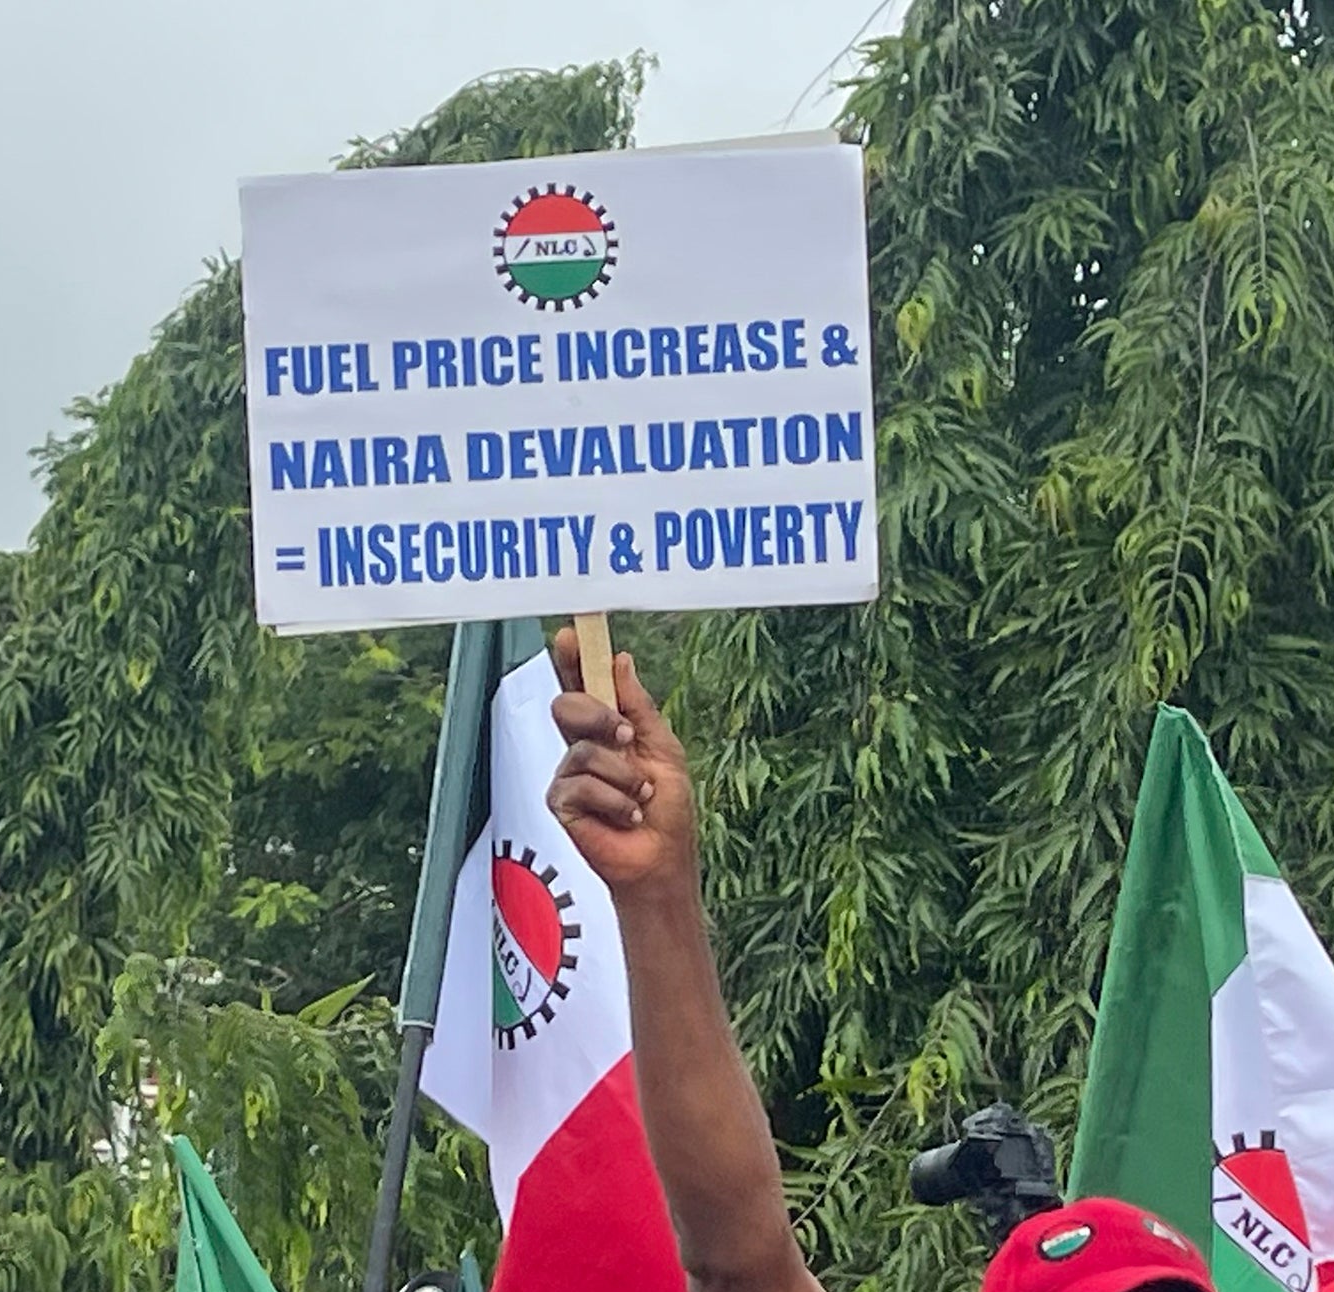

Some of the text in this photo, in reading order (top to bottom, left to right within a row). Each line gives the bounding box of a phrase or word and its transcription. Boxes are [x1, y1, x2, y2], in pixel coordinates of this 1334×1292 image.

[534, 237, 579, 258] NLC
[265, 318, 858, 395] FUEL PRICE INCREASE &
[269, 411, 863, 491] NAIRA DEVALUATION
[275, 501, 864, 587] = INSECURITY & POVERTY
[1230, 1207, 1297, 1268] NLC
